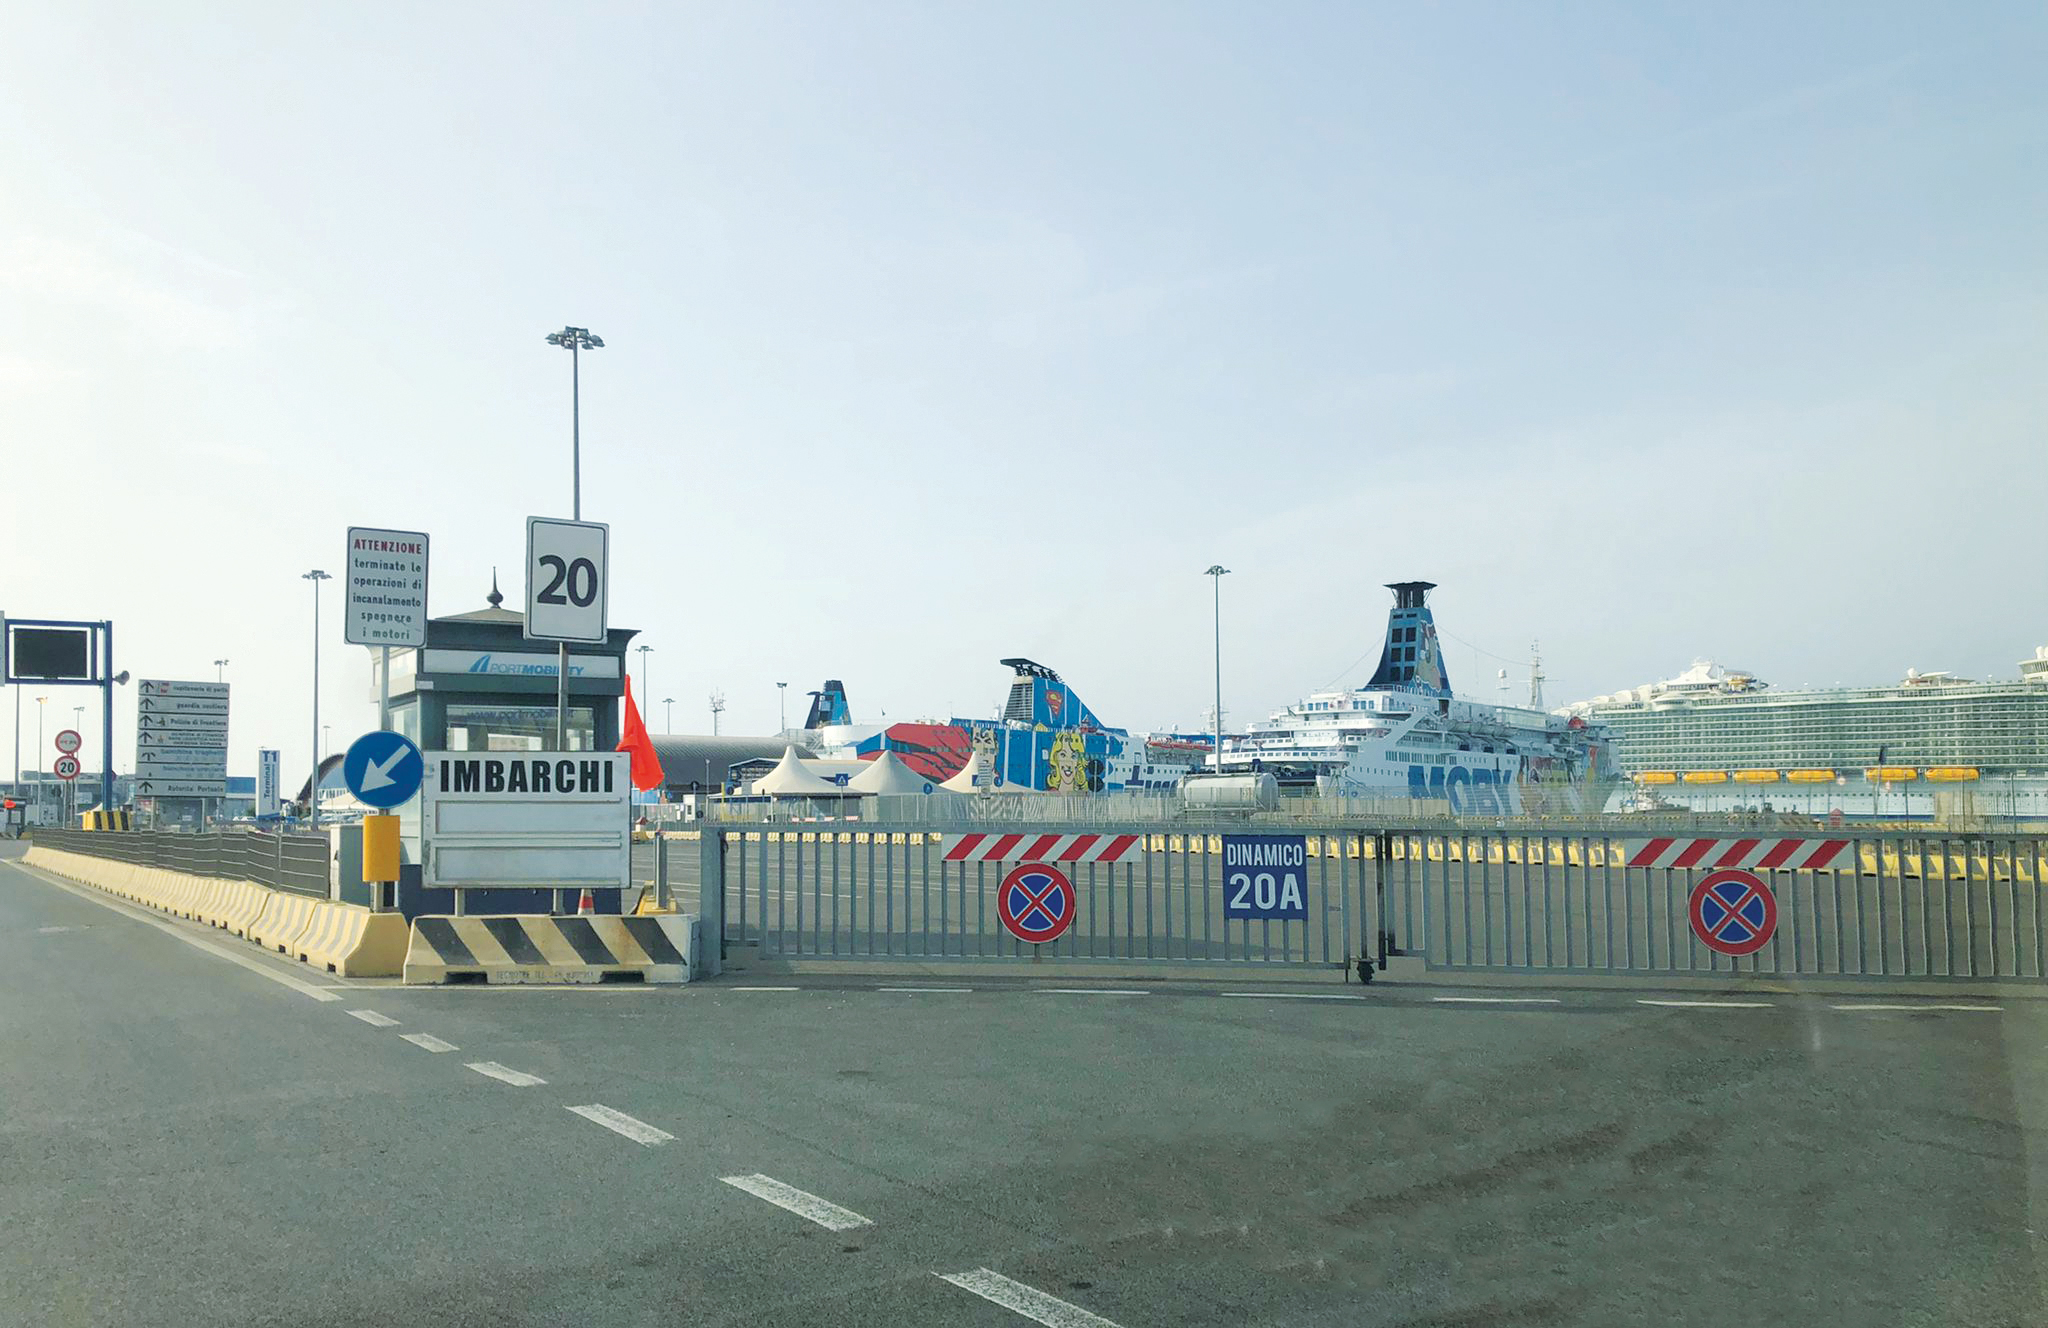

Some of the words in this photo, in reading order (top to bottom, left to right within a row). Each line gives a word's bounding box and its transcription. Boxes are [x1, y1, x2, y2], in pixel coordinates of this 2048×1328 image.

[354, 539, 422, 554] ATTENZIONE
[411, 561, 421, 573] le
[354, 577, 407, 589] operazioni
[412, 579, 421, 590] di
[537, 554, 598, 608] 20
[353, 592, 421, 607] incanalamento
[361, 611, 412, 624] spegnere
[363, 626, 366, 637] i
[372, 630, 410, 640] motori
[262, 751, 277, 762] T1
[60, 762, 75, 773] 20
[440, 759, 613, 793] IMBARCHI
[1407, 765, 1513, 817] MOBY
[1227, 843, 1303, 866] DINAMICO
[1229, 872, 1303, 910] 20A
